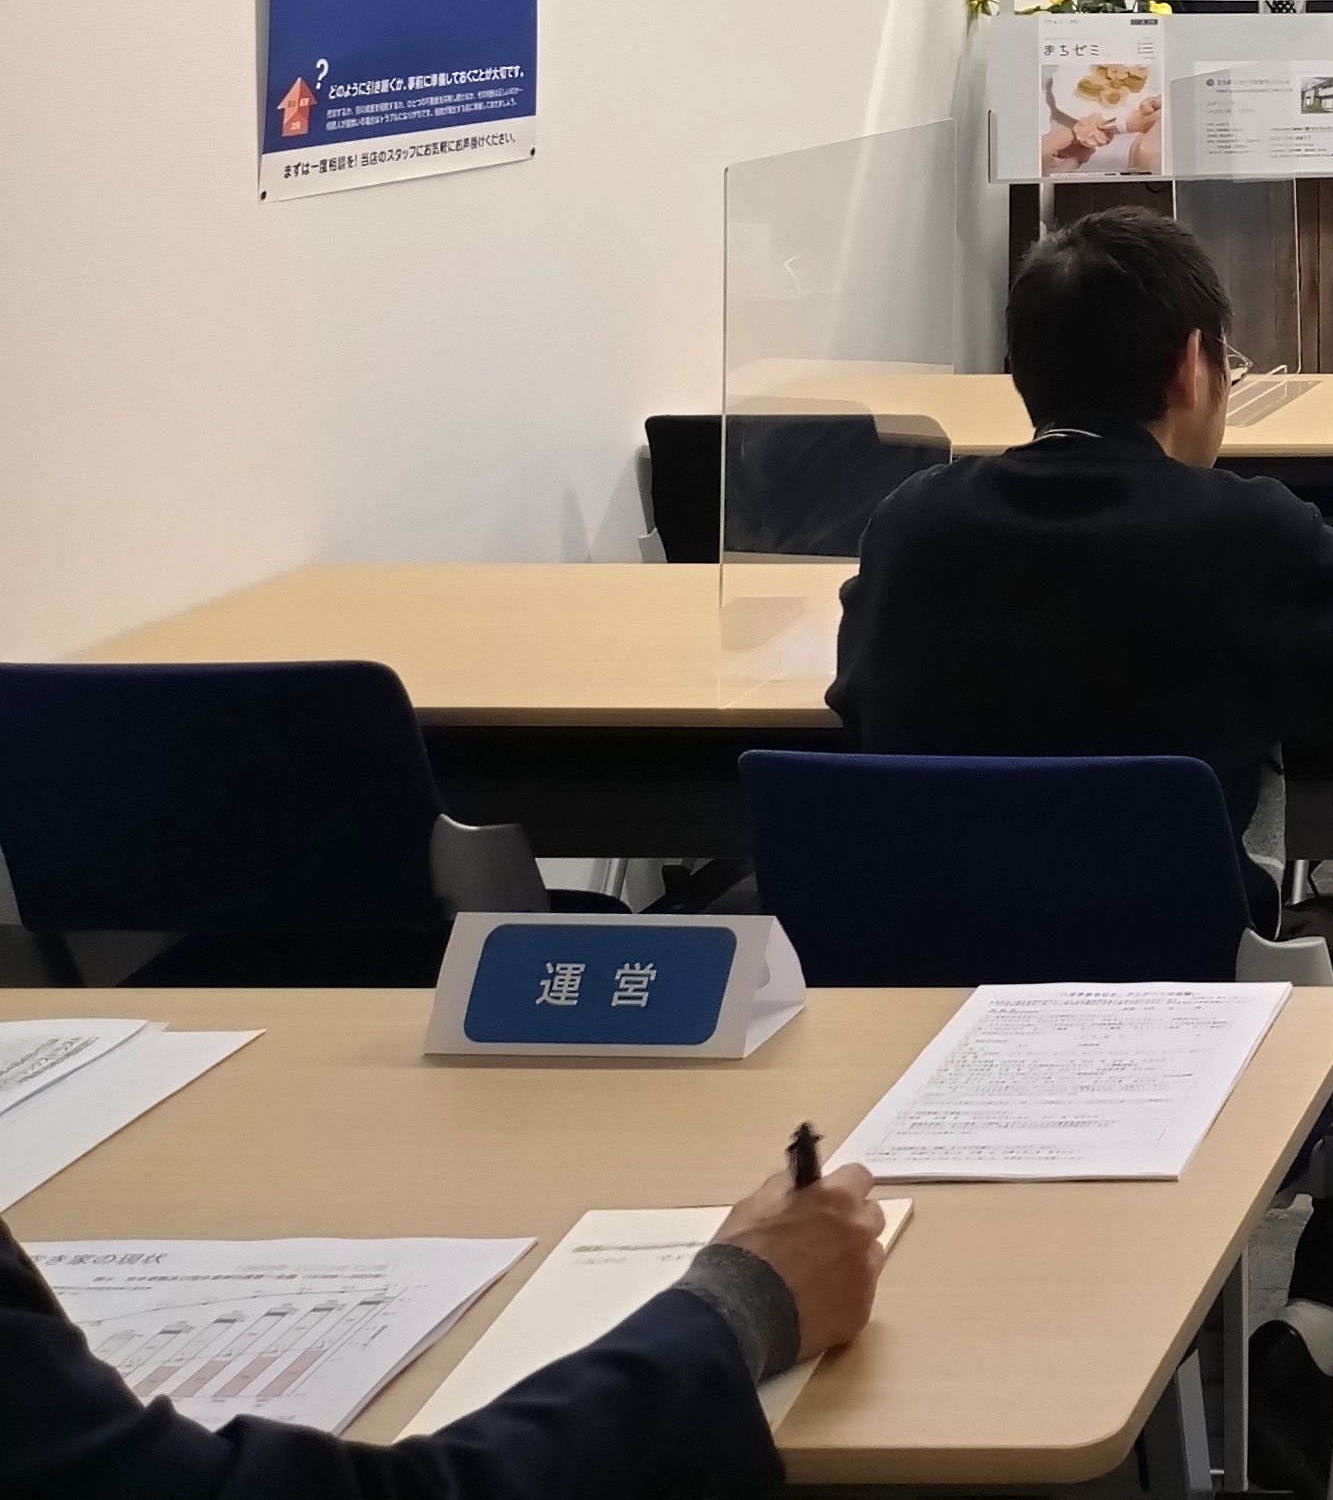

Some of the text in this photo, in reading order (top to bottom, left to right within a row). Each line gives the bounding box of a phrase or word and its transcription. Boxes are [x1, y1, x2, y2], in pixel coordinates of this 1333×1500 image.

[1043, 45, 1099, 56] まちゼミ
[536, 962, 657, 1007] 運営
